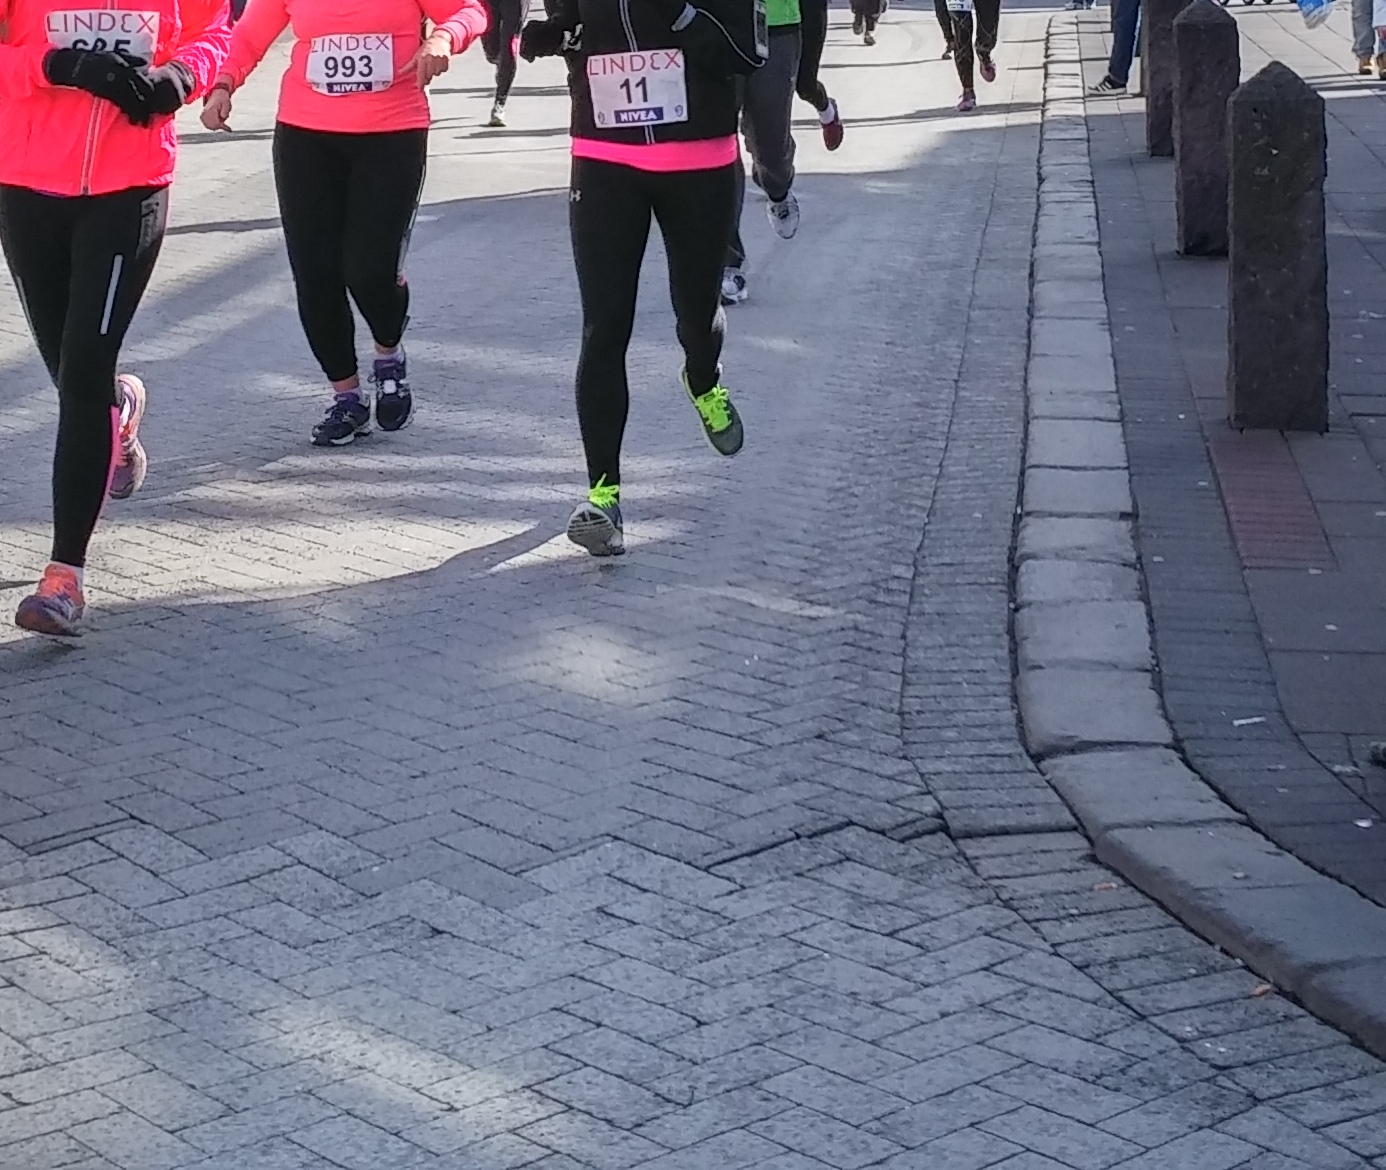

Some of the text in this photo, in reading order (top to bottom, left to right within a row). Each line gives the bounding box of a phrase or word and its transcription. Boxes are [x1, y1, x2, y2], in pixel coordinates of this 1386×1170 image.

[47, 12, 154, 34] LINDEX
[311, 36, 390, 53] LINDEX
[324, 55, 373, 78] 993
[589, 50, 681, 75] LINDEX
[332, 83, 367, 92] NIVEA
[619, 76, 649, 104] 11
[620, 110, 658, 122] NIVEA
